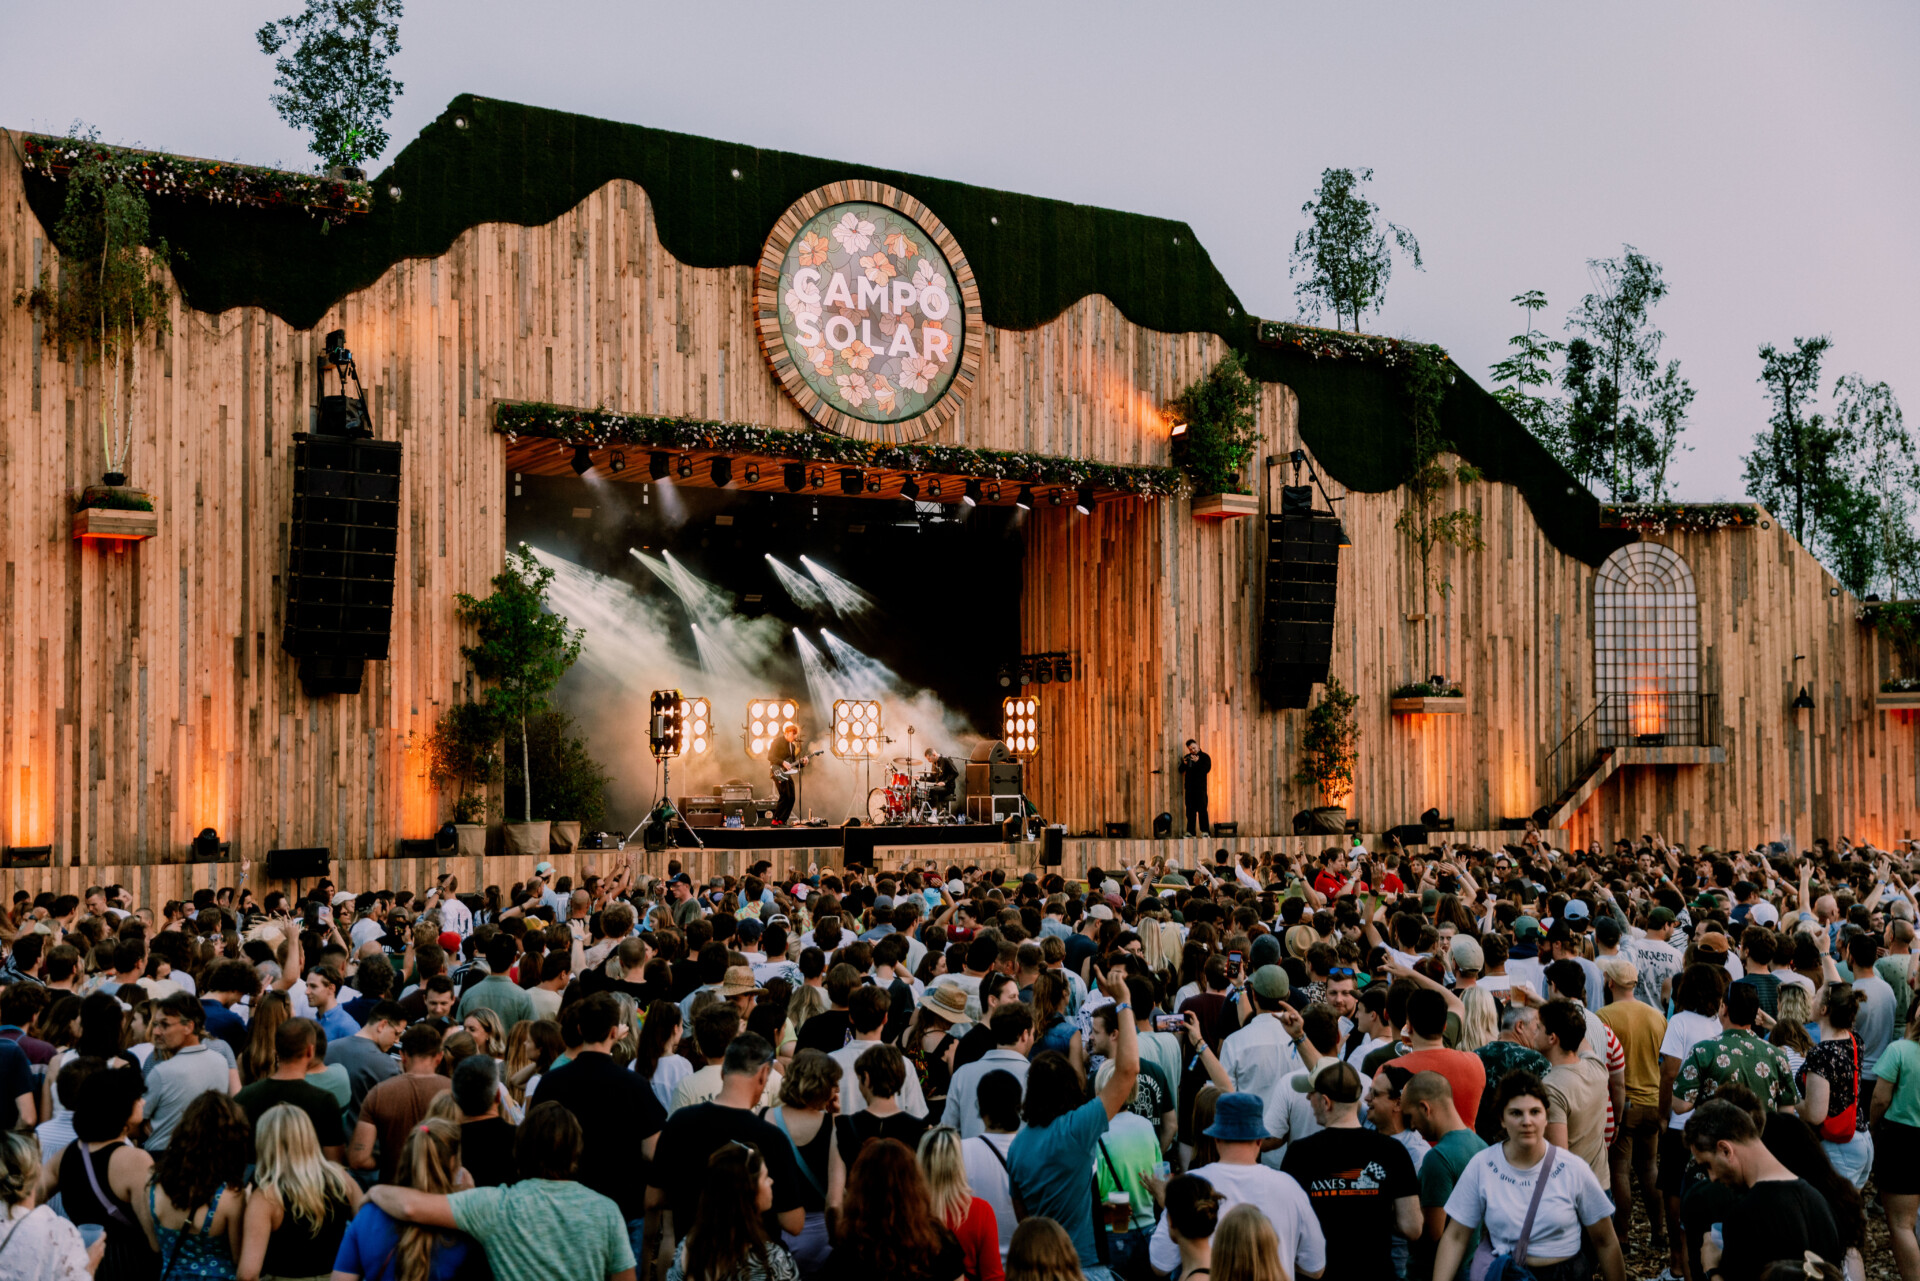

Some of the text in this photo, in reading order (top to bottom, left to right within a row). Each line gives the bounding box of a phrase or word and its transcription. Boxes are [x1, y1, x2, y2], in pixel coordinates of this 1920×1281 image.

[793, 268, 950, 320] CAMPO
[795, 312, 948, 362] SOLAR
[1310, 1178, 1346, 1190] AXXES
